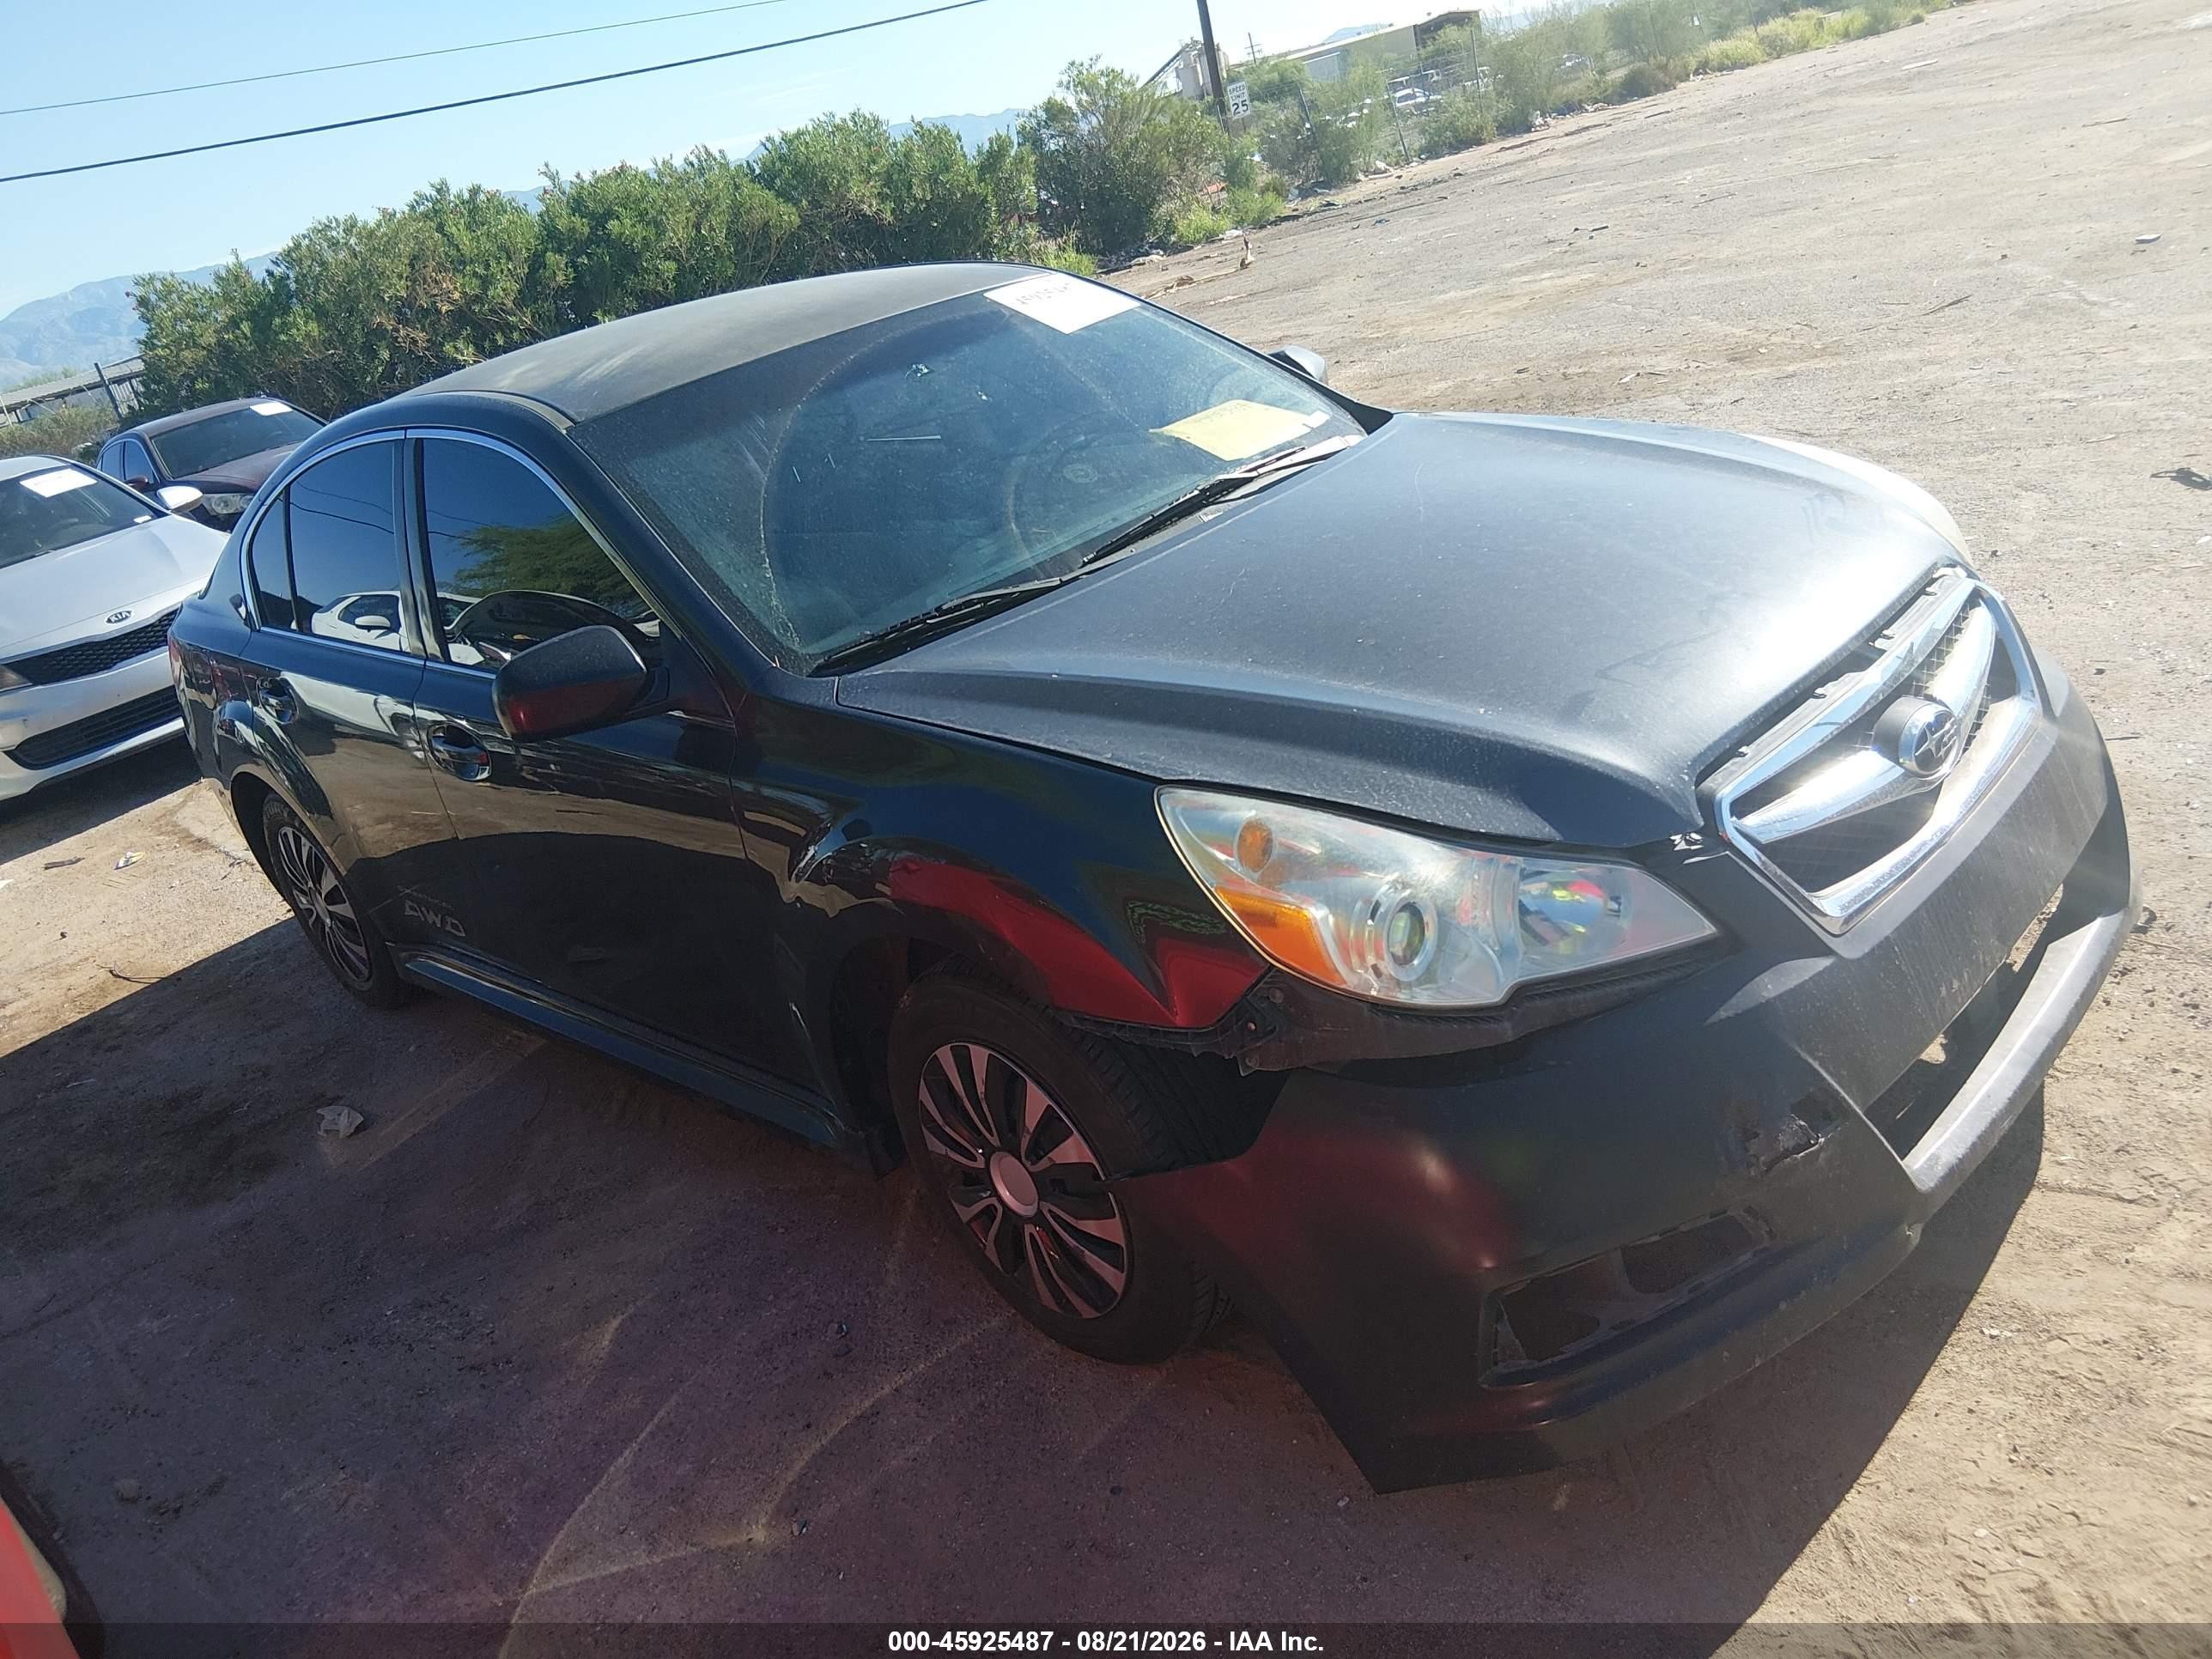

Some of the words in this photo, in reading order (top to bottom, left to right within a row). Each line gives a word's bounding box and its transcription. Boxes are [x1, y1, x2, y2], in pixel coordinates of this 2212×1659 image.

[1228, 84, 1246, 95] SPEED
[1231, 92, 1245, 102] LIMIT
[1232, 99, 1249, 116] 25
[108, 611, 131, 623] KIA
[404, 900, 466, 937] AWD
